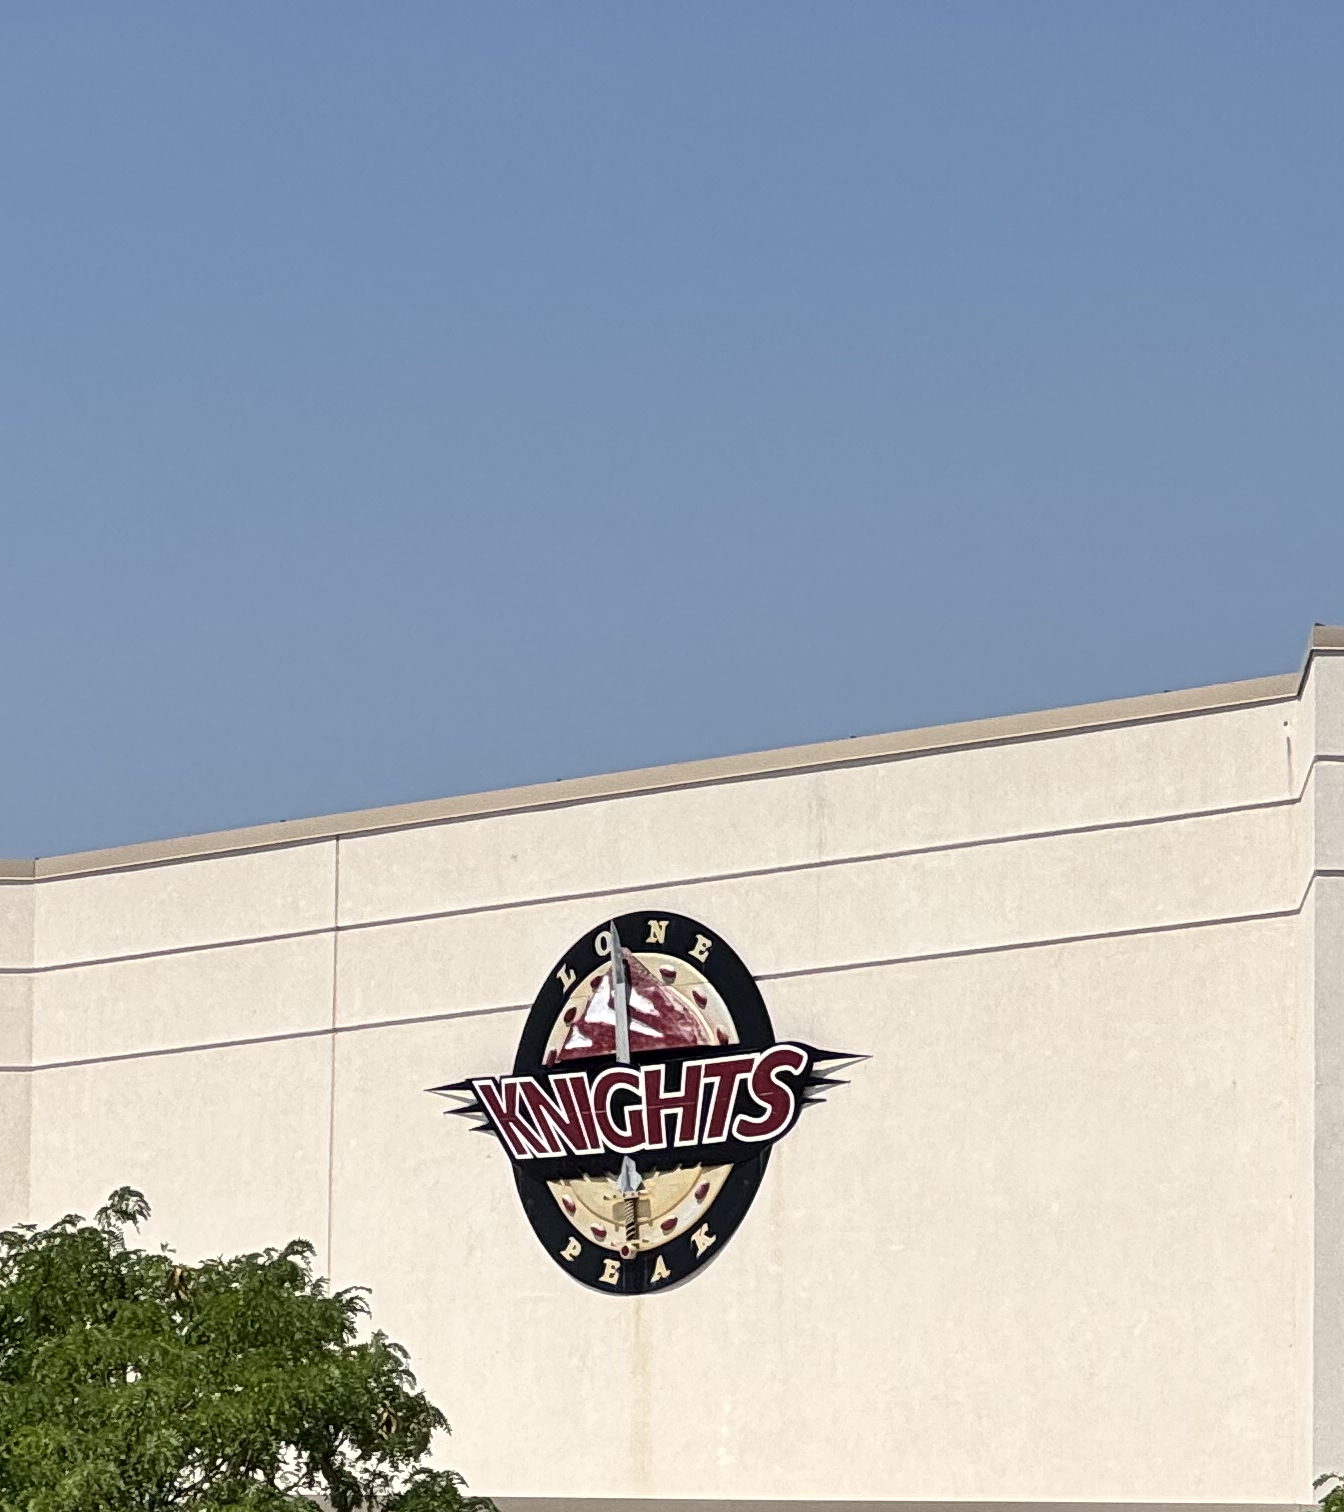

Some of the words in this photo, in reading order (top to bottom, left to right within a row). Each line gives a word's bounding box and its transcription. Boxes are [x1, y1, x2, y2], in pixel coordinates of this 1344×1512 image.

[556, 920, 713, 993] LONE
[473, 1044, 808, 1160] KNIGHTS
[560, 1223, 718, 1286] PEAK
